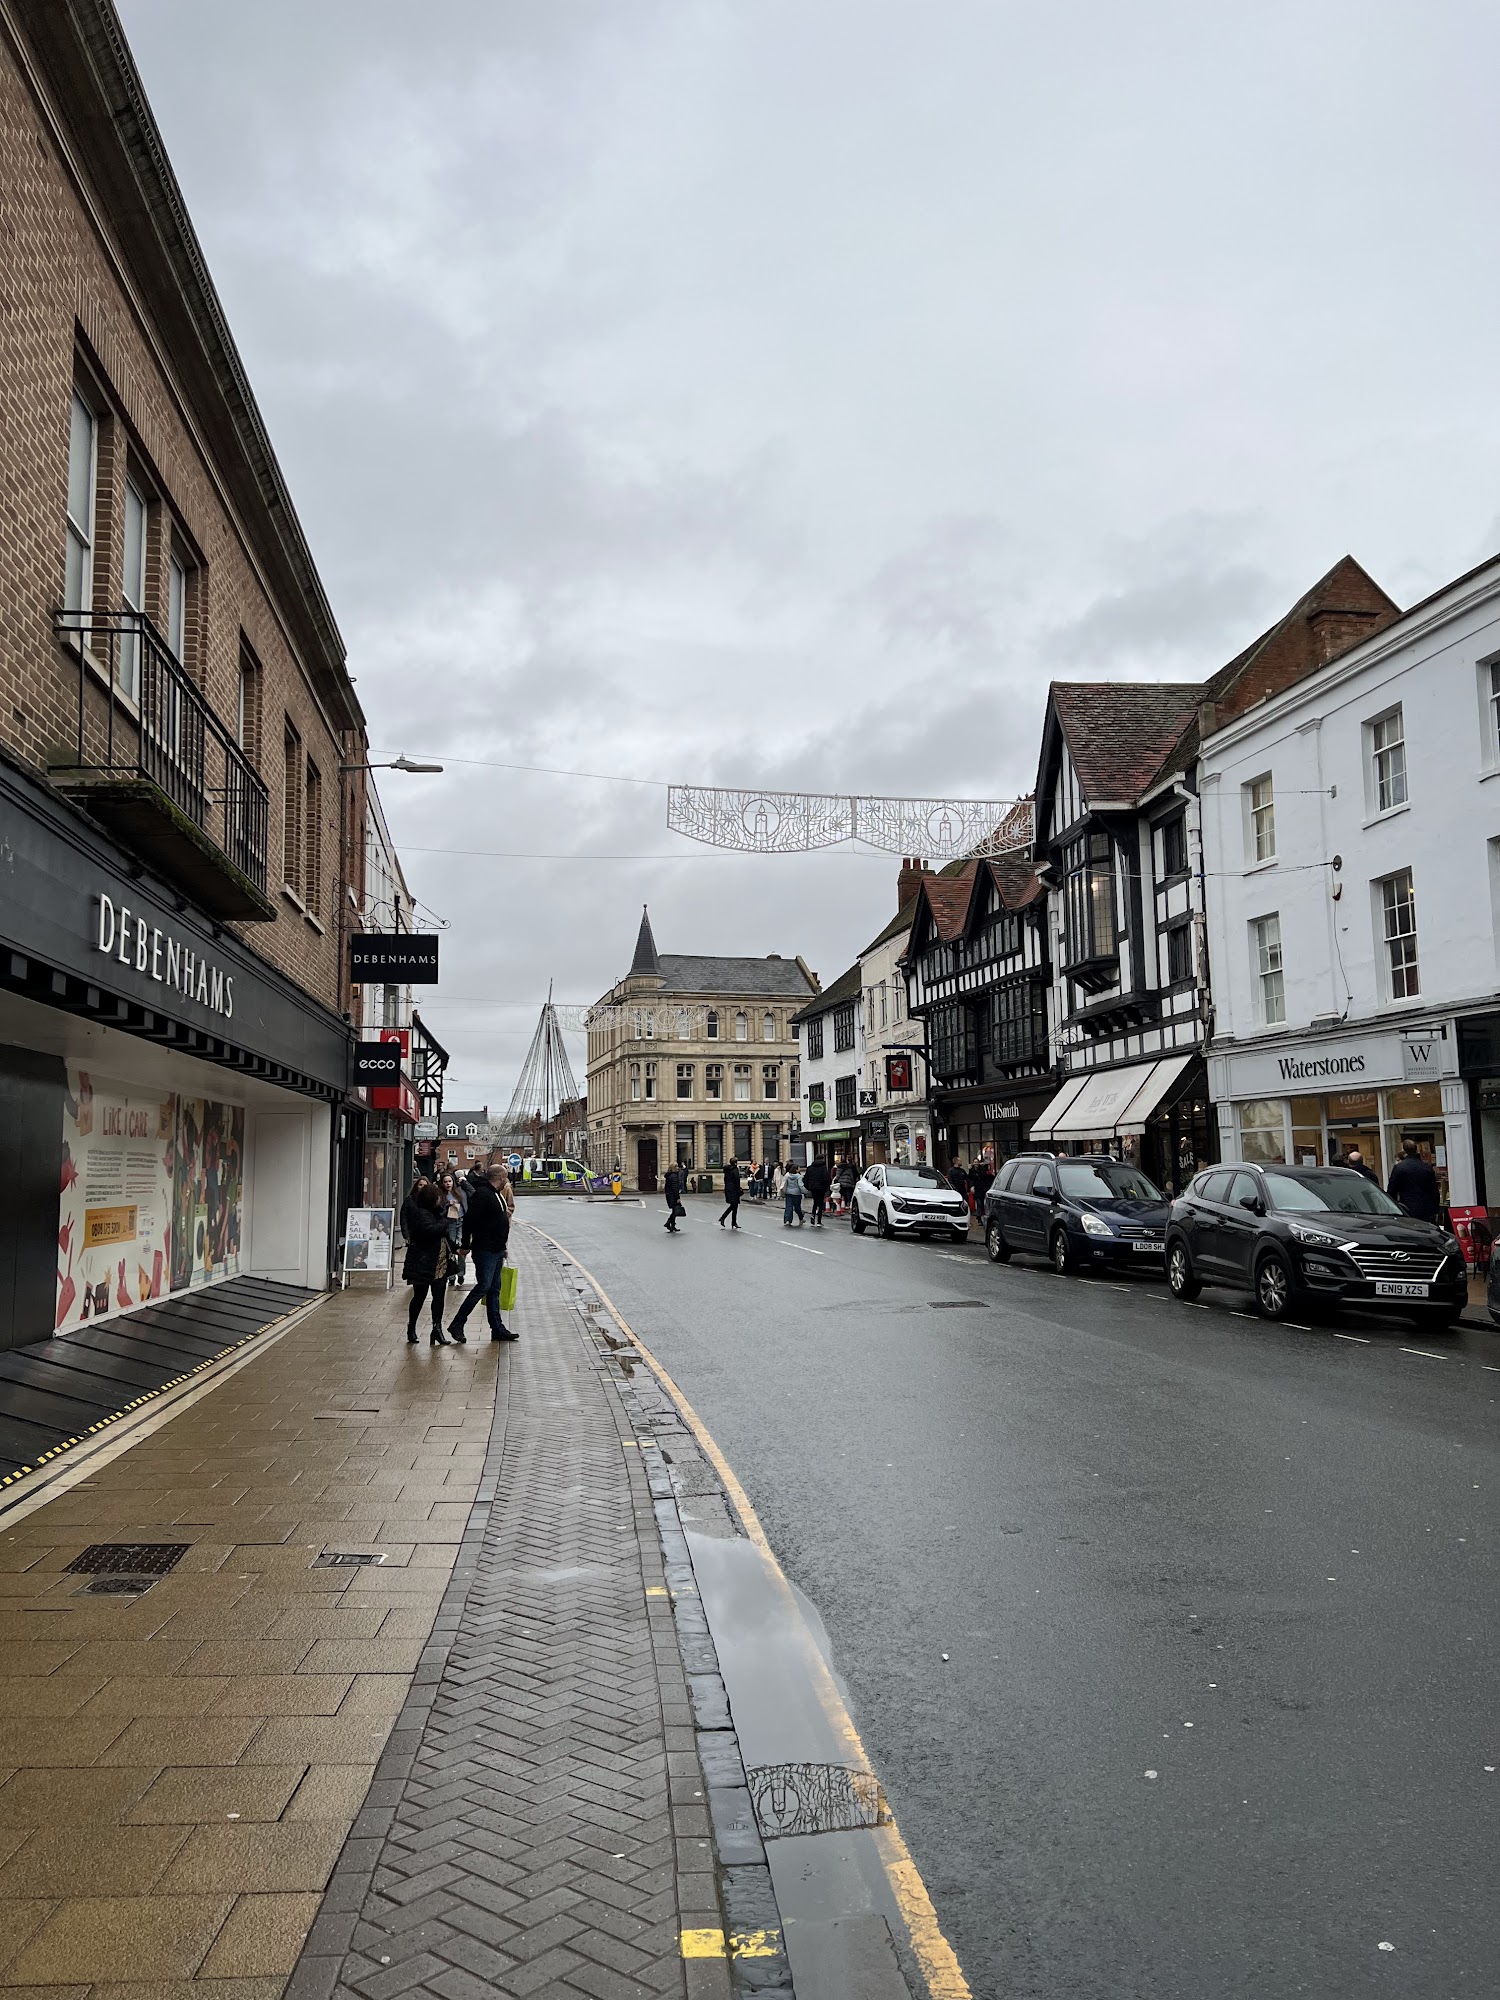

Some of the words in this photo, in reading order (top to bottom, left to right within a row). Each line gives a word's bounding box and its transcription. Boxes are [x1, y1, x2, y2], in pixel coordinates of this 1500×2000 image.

[99, 893, 234, 1018] DEBENHAMS
[353, 954, 437, 964] DEBENHAMS
[1408, 1044, 1433, 1063] W
[359, 1060, 396, 1069] ecco
[1277, 1055, 1365, 1080] Waterstones
[720, 1112, 749, 1120] LLOYDS
[750, 1112, 771, 1120] BANK
[983, 1102, 1019, 1119] WHSmith
[129, 1110, 148, 1138] CARE
[1179, 1152, 1194, 1168] SALE
[1381, 1283, 1403, 1294] EN19
[1405, 1285, 1423, 1295] XZS
